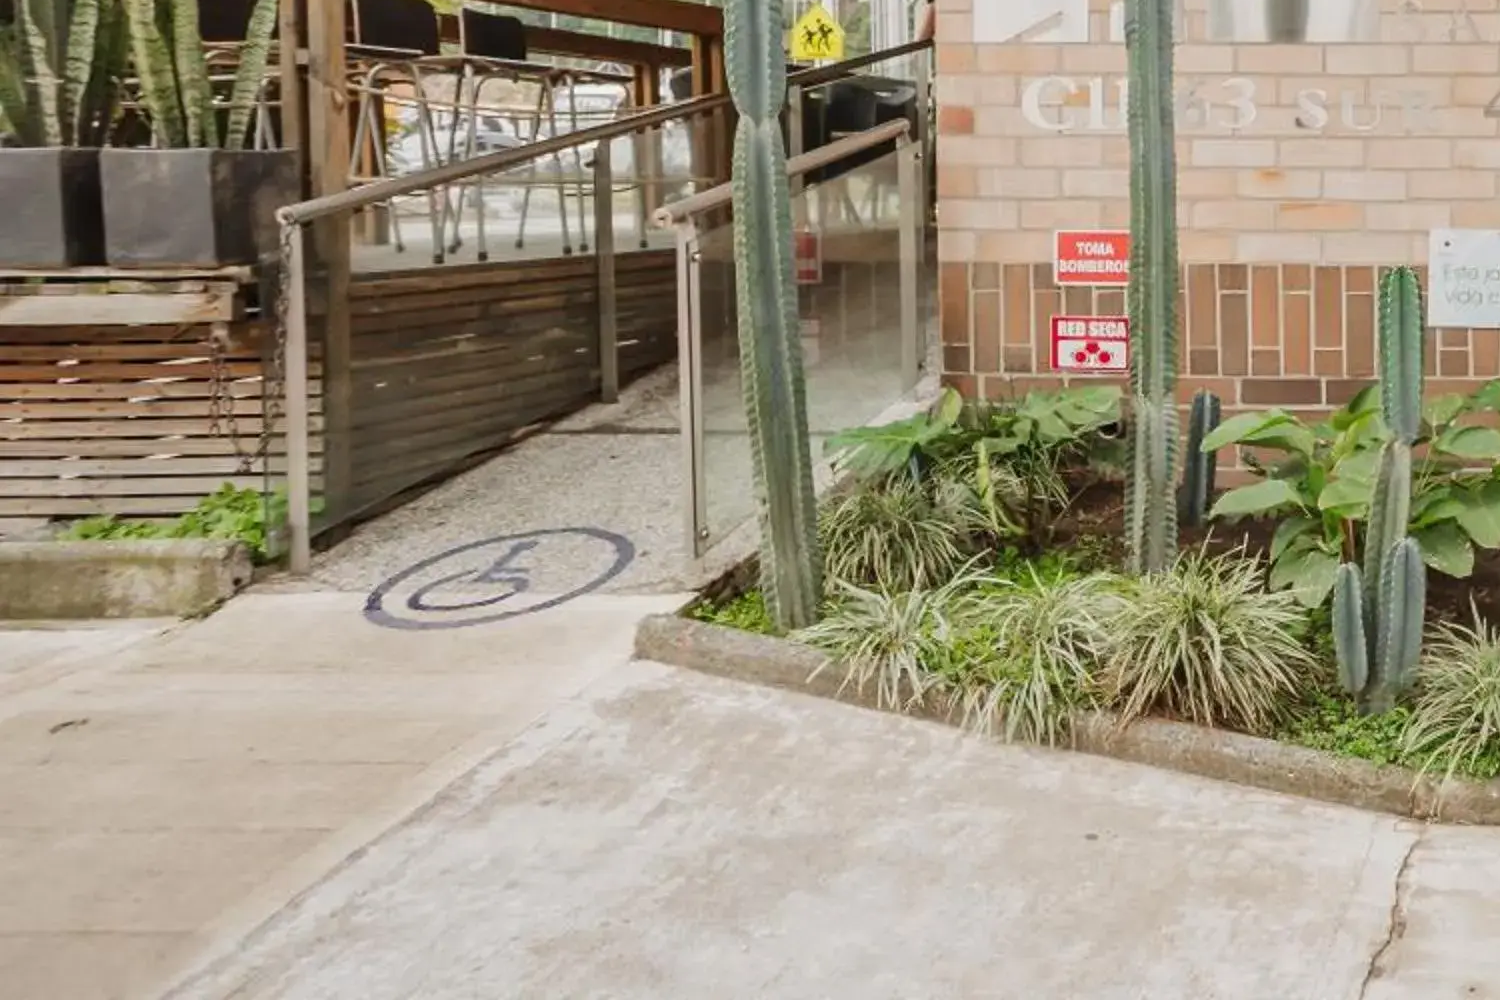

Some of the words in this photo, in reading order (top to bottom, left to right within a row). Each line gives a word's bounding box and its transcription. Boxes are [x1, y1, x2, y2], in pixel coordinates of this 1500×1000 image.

[1173, 76, 1257, 129] 63
[1076, 242, 1115, 256] TOMA
[1088, 321, 1127, 337] SECA
